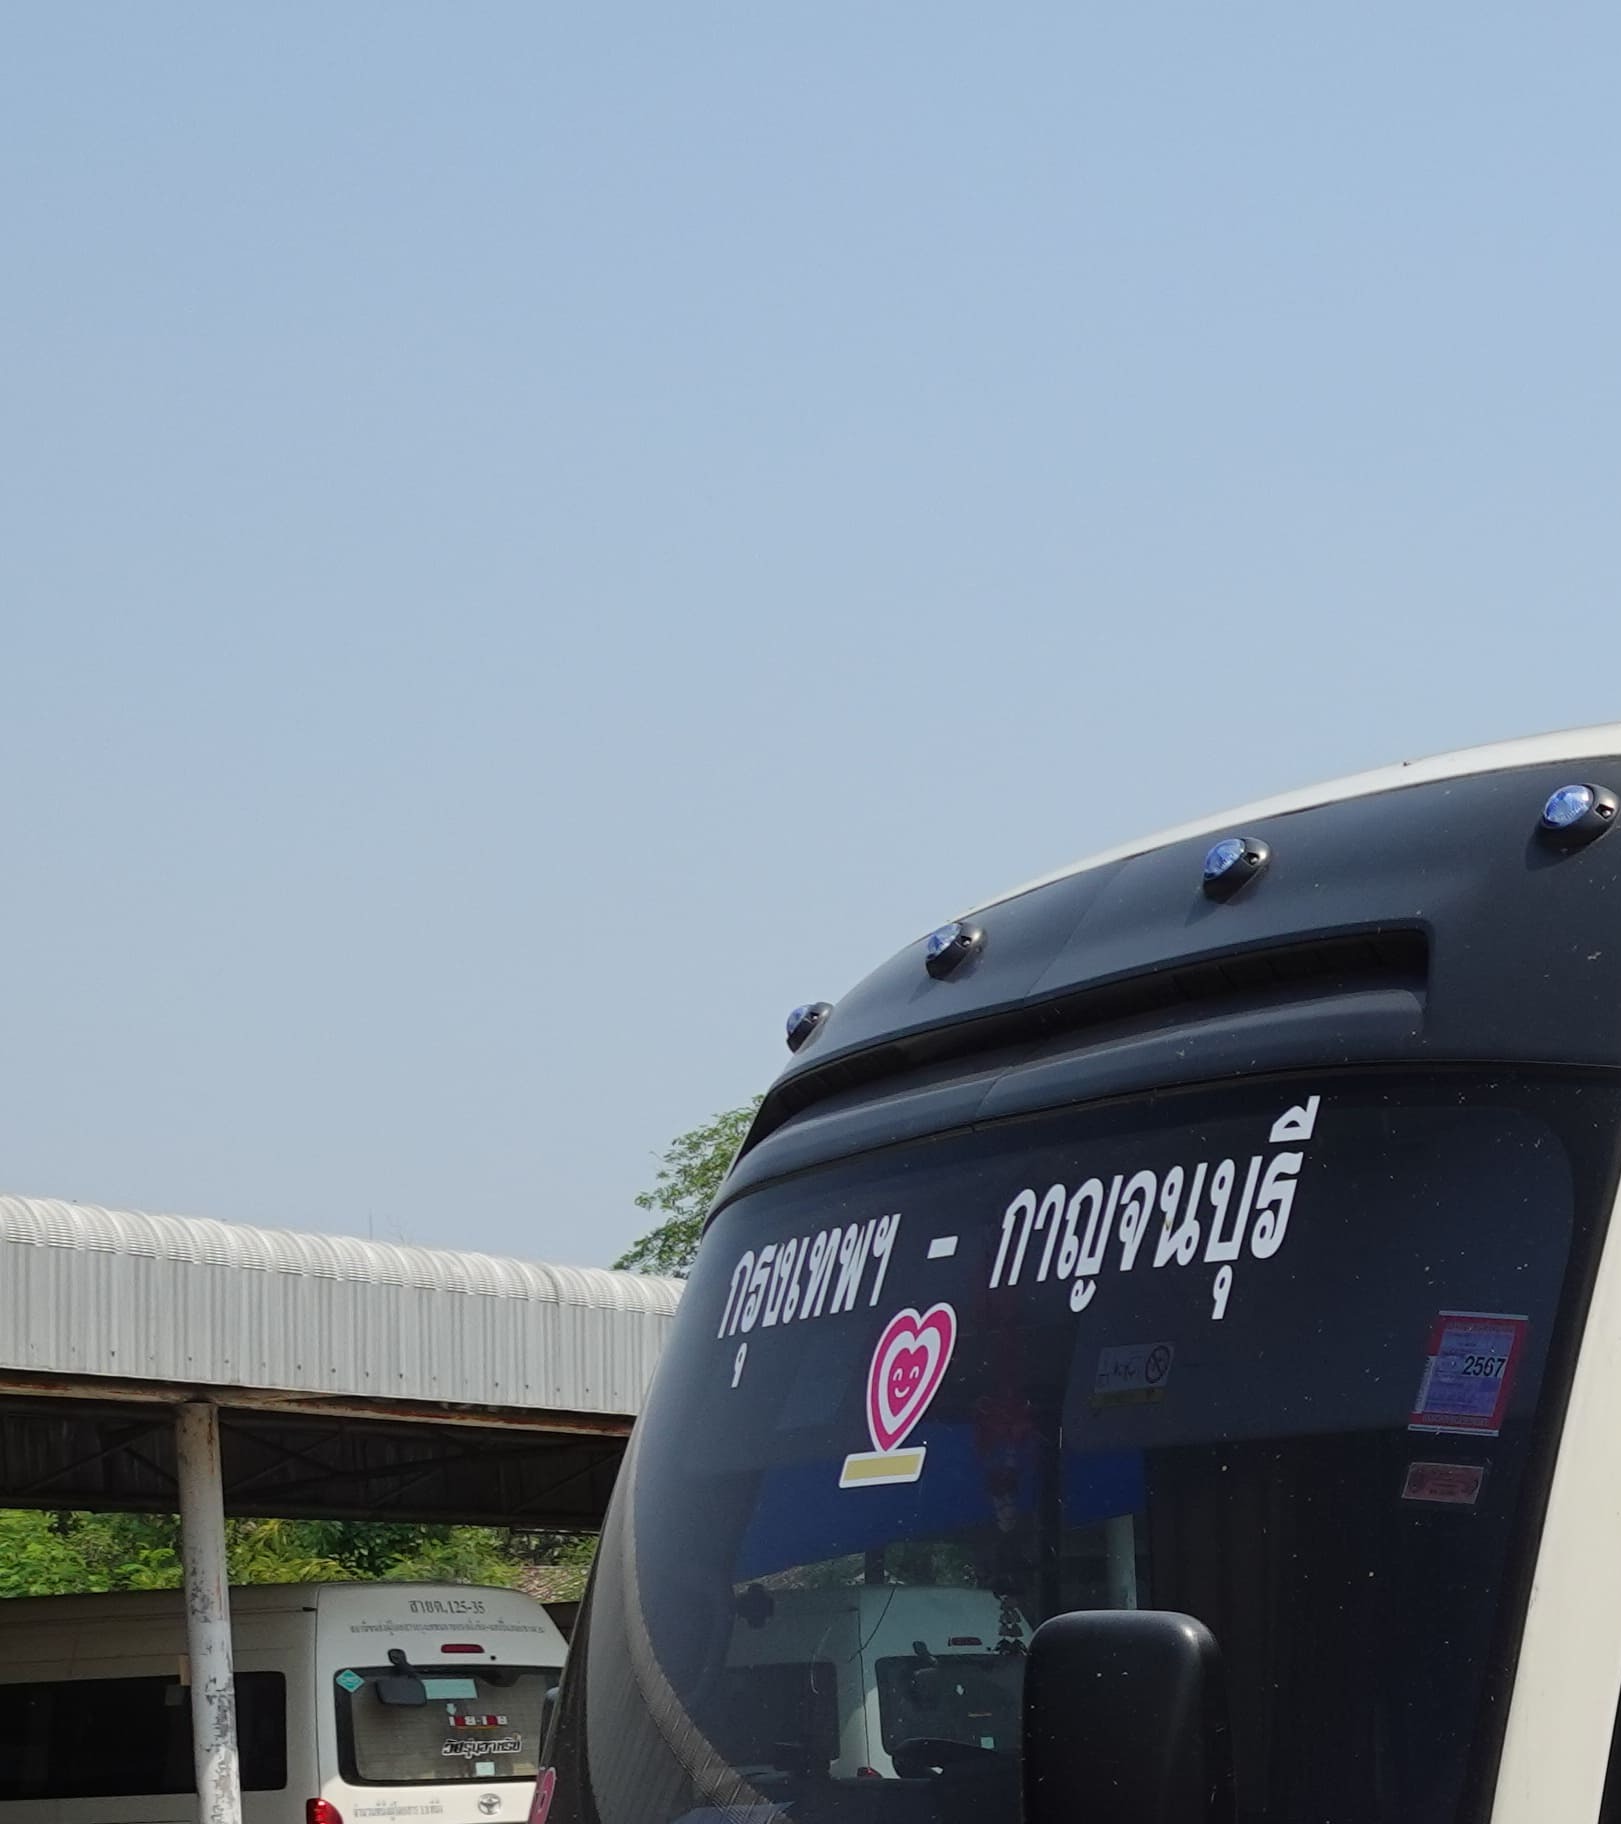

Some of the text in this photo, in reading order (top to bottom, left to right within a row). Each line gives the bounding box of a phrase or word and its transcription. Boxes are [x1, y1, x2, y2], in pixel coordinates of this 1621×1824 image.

[717, 1213, 901, 1388] กรุงเทพฯ
[989, 1095, 1321, 1320] กาญจนบุรี
[1461, 1355, 1507, 1378] 2567
